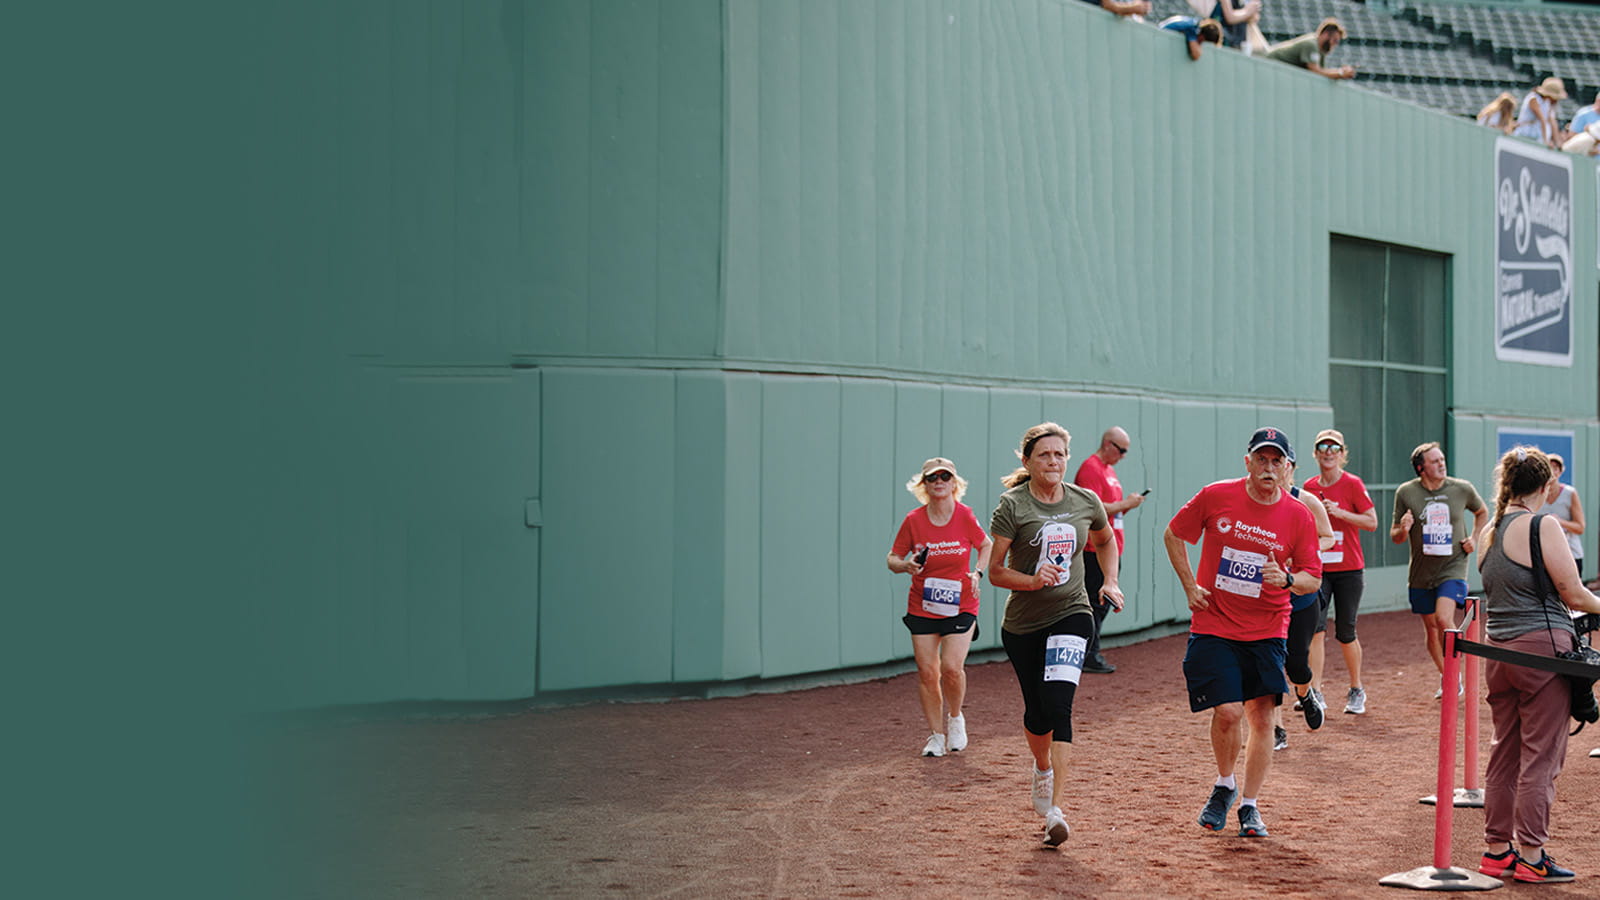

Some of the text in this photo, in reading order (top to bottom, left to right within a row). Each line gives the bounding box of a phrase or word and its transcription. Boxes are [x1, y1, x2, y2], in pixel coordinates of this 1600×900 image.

[1235, 520, 1277, 540] Raytheon
[1430, 533, 1447, 545] 1102
[1233, 529, 1284, 552] Technologies
[1228, 561, 1257, 579] 1059
[931, 588, 954, 603] 1046
[1055, 647, 1081, 665] 1473
